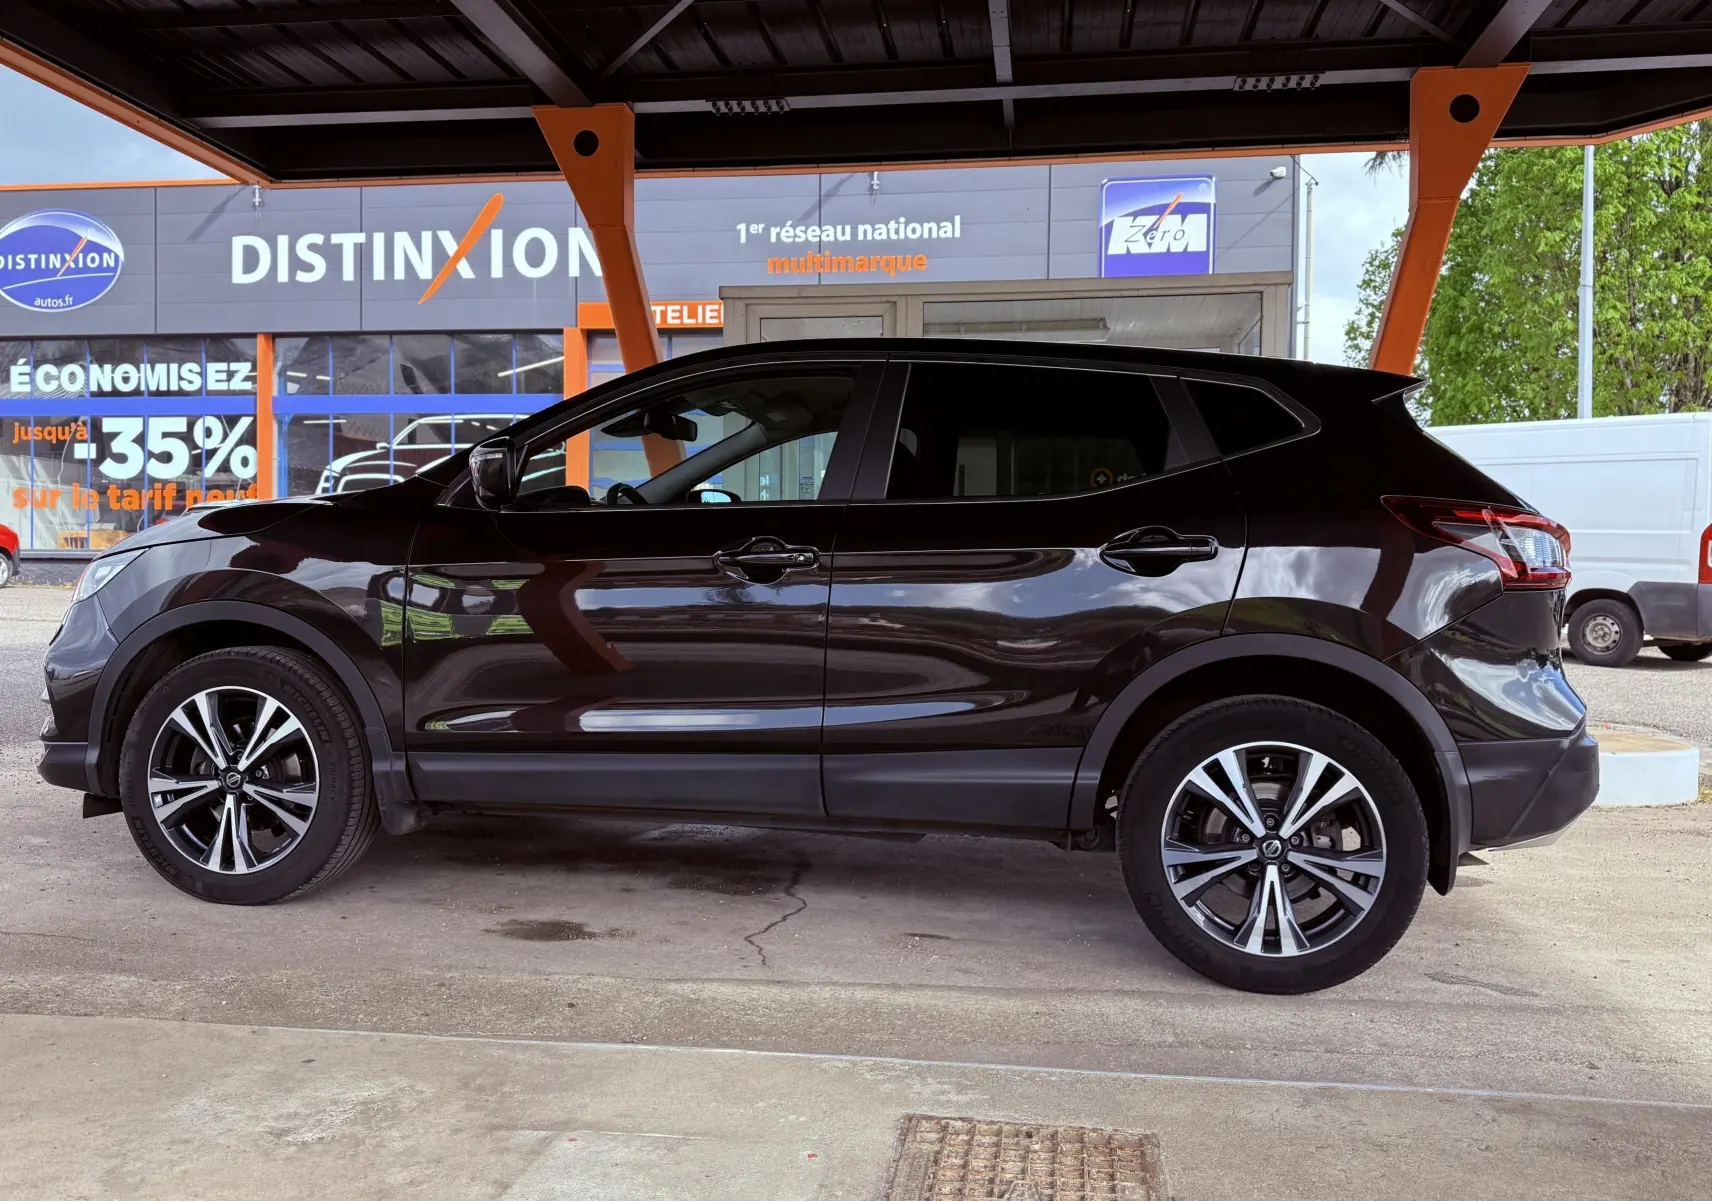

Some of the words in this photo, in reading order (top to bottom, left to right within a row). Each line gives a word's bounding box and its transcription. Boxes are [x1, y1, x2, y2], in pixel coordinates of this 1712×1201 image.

[736, 223, 765, 243] 1er
[770, 221, 851, 243] réseau
[858, 215, 961, 240] national
[1107, 214, 1208, 254] KM
[231, 193, 603, 304] DISTINXION
[767, 250, 928, 277] multimarque
[34, 294, 73, 308] autos.fr
[651, 304, 724, 324] TELIE
[10, 358, 252, 392] ÉCONOMISEZ
[13, 422, 88, 444] jusqu'à
[74, 416, 257, 480] -35%
[12, 486, 62, 510] sur
[72, 483, 99, 510] le
[107, 483, 176, 511] tarif
